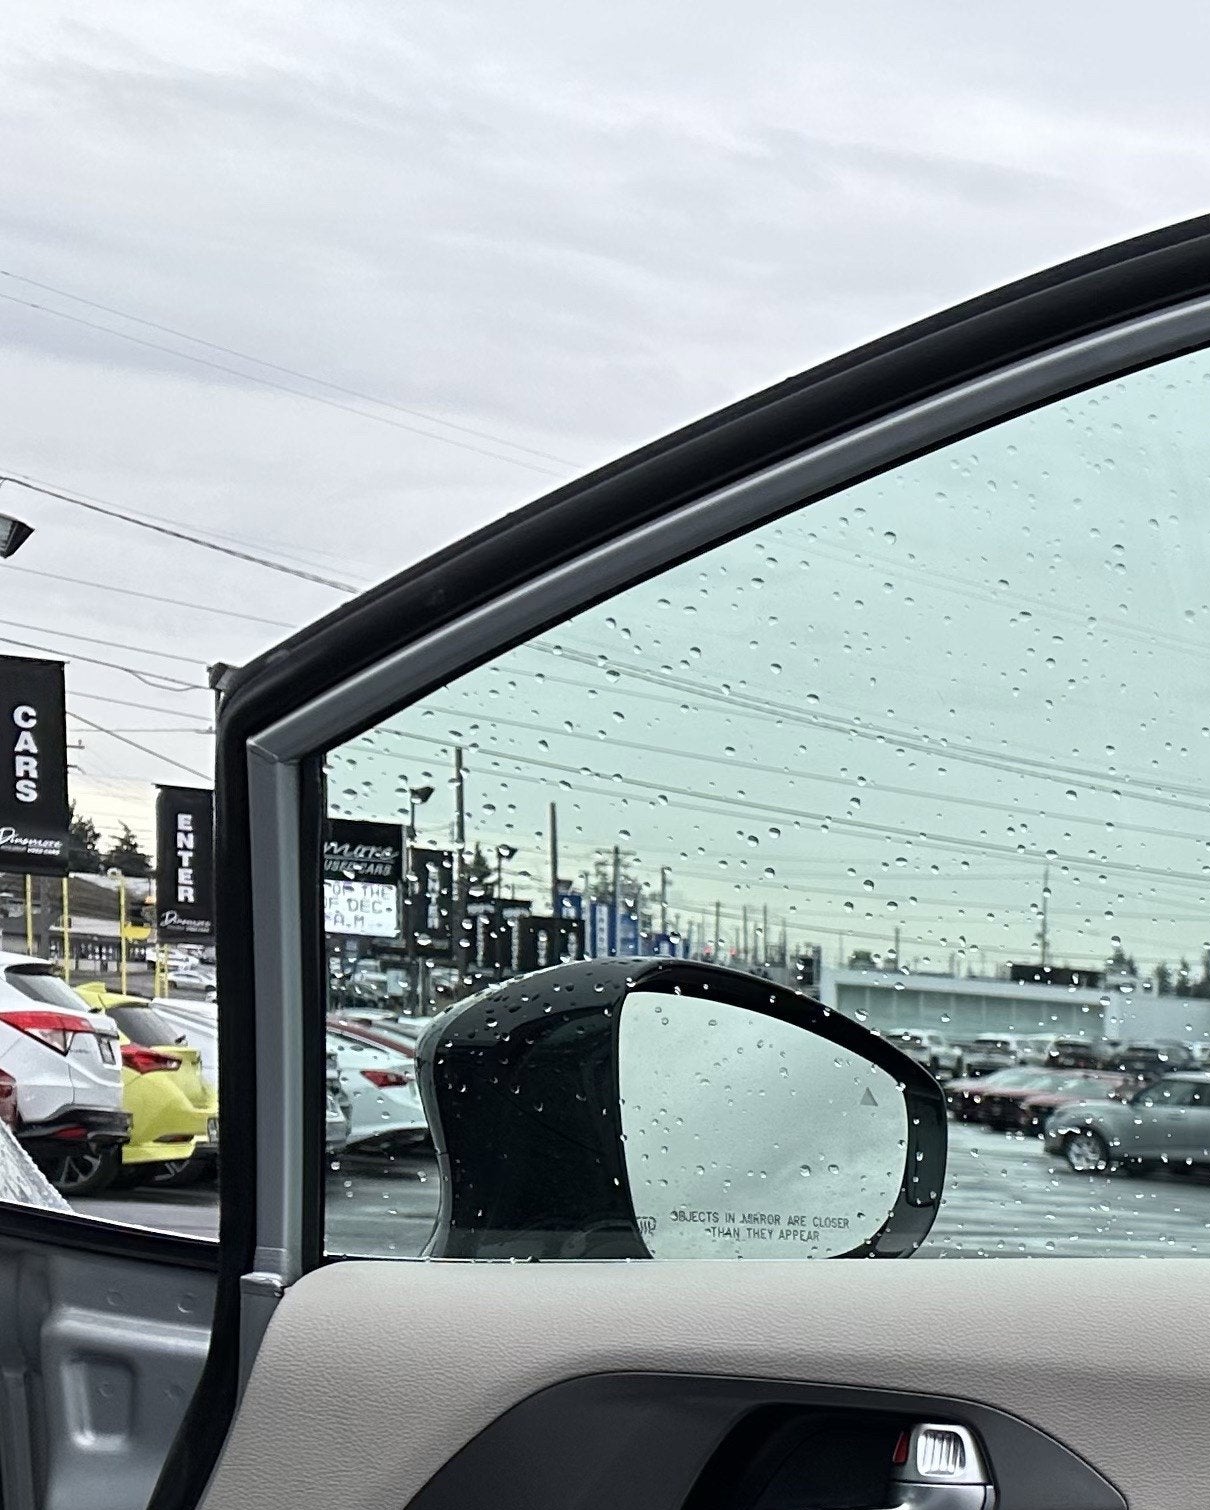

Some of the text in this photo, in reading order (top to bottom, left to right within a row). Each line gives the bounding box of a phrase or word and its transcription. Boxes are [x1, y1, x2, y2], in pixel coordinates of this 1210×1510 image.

[13, 705, 38, 803] CARS
[177, 813, 194, 903] ENTER
[669, 1210, 850, 1229] OBJECTS IN MIRROR ARE CLOSER
[711, 1226, 820, 1242] THAN THEY APPEAR
